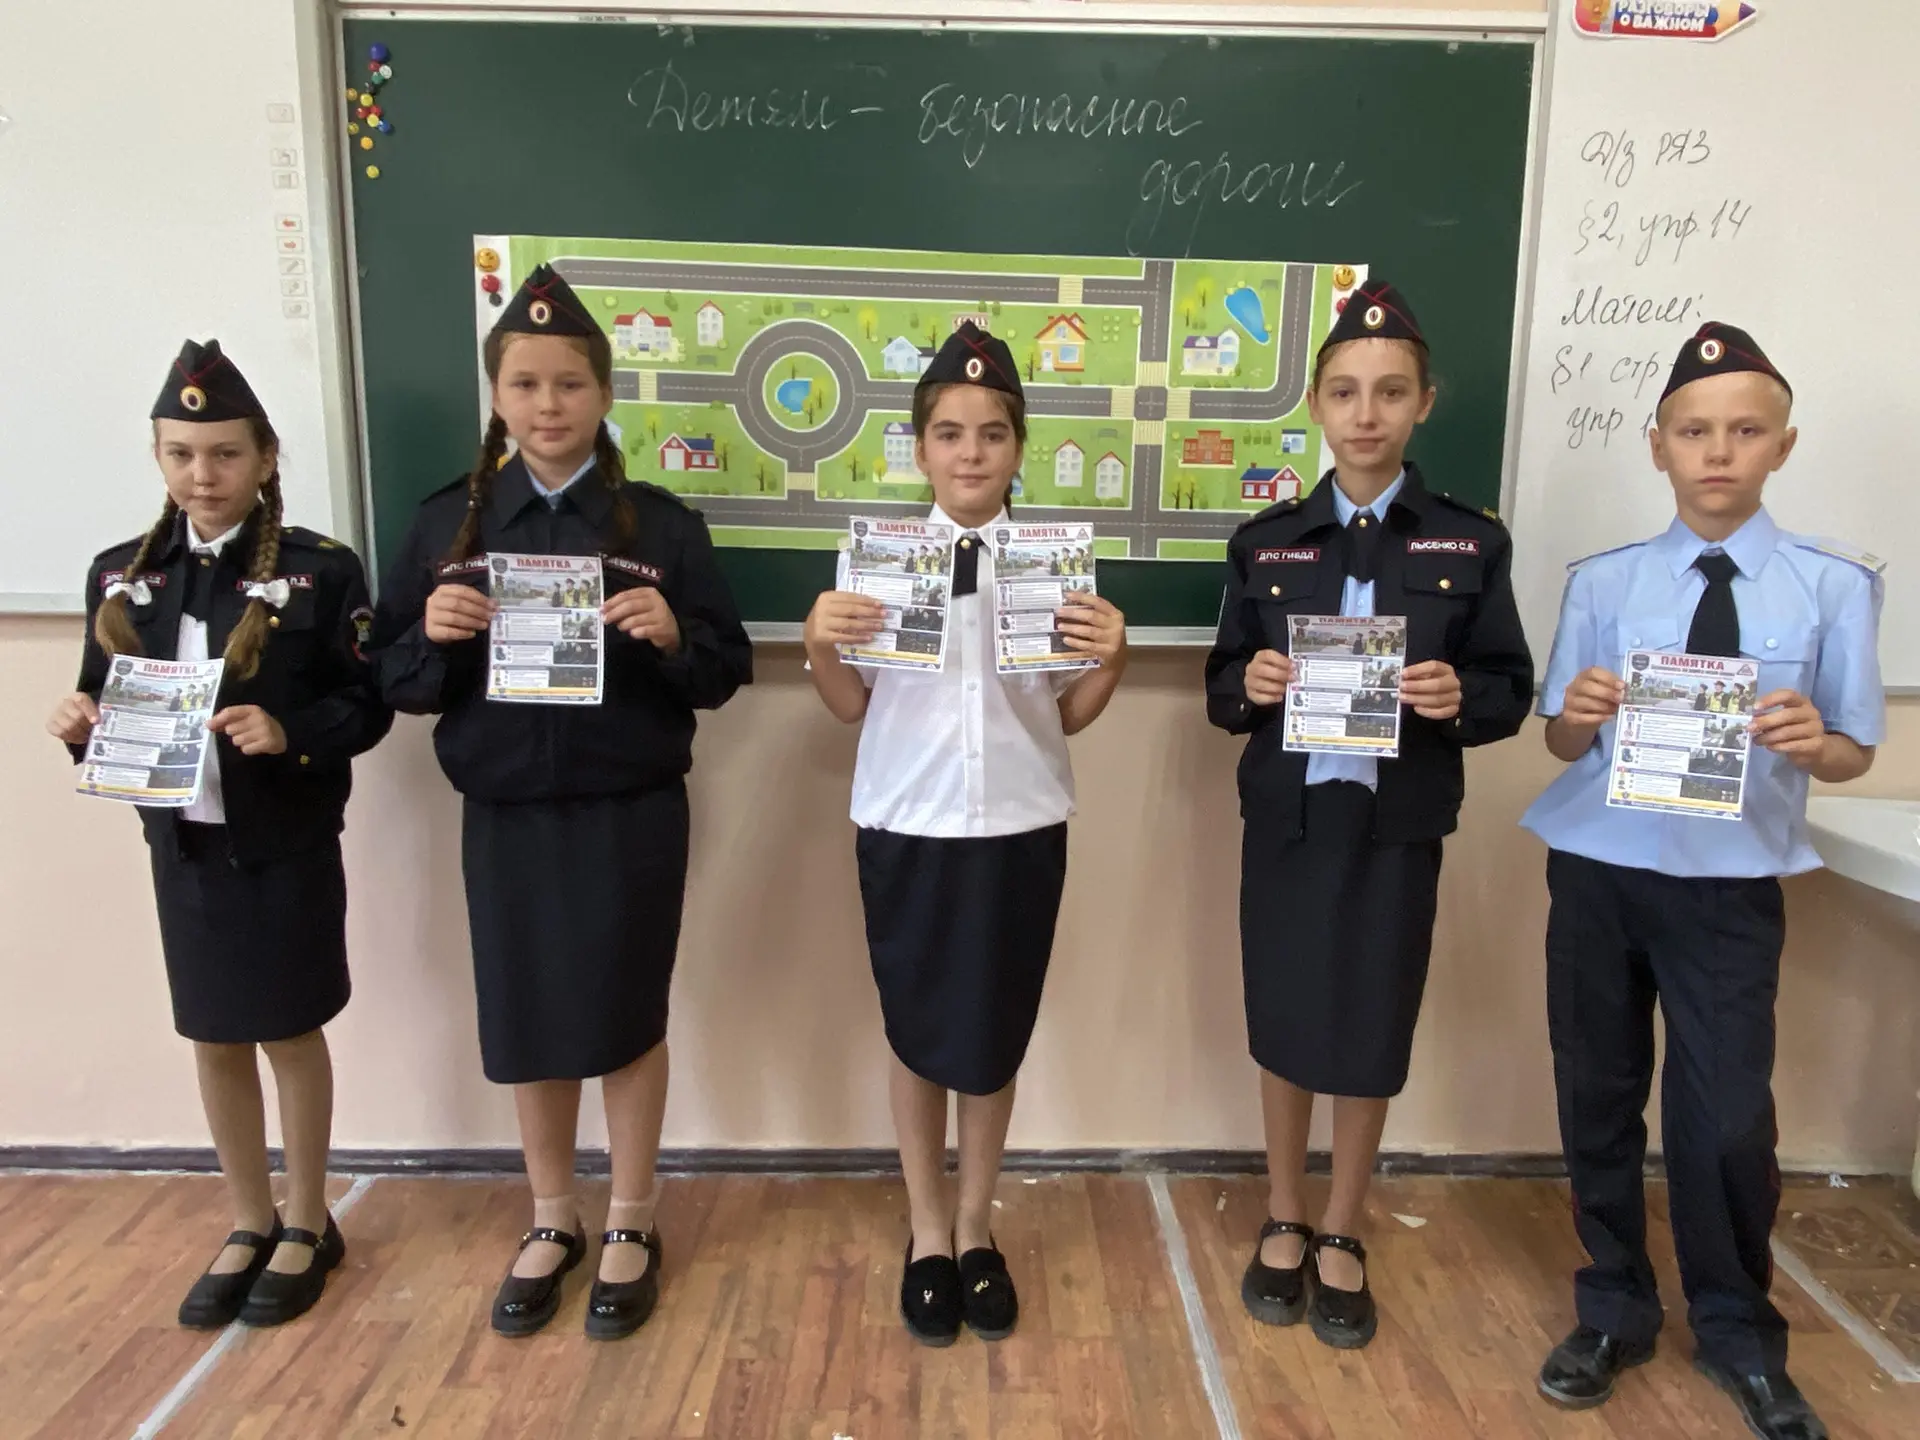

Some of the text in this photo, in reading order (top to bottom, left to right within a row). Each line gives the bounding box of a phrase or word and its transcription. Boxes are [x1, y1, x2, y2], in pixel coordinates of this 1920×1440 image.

[1619, 14, 1705, 32] О ВАЖНОМ
[627, 58, 840, 132] Детям
[1711, 199, 1752, 240] 14
[876, 521, 927, 534] ПАМЯТКА
[1018, 527, 1068, 538] ПАМЯТКА
[1258, 551, 1315, 561] ДПС ГИБДД
[516, 557, 573, 569] ПАМЯТКА
[143, 662, 198, 675] ПАМЯТКА
[1660, 655, 1725, 671] ПАМЯТКА
